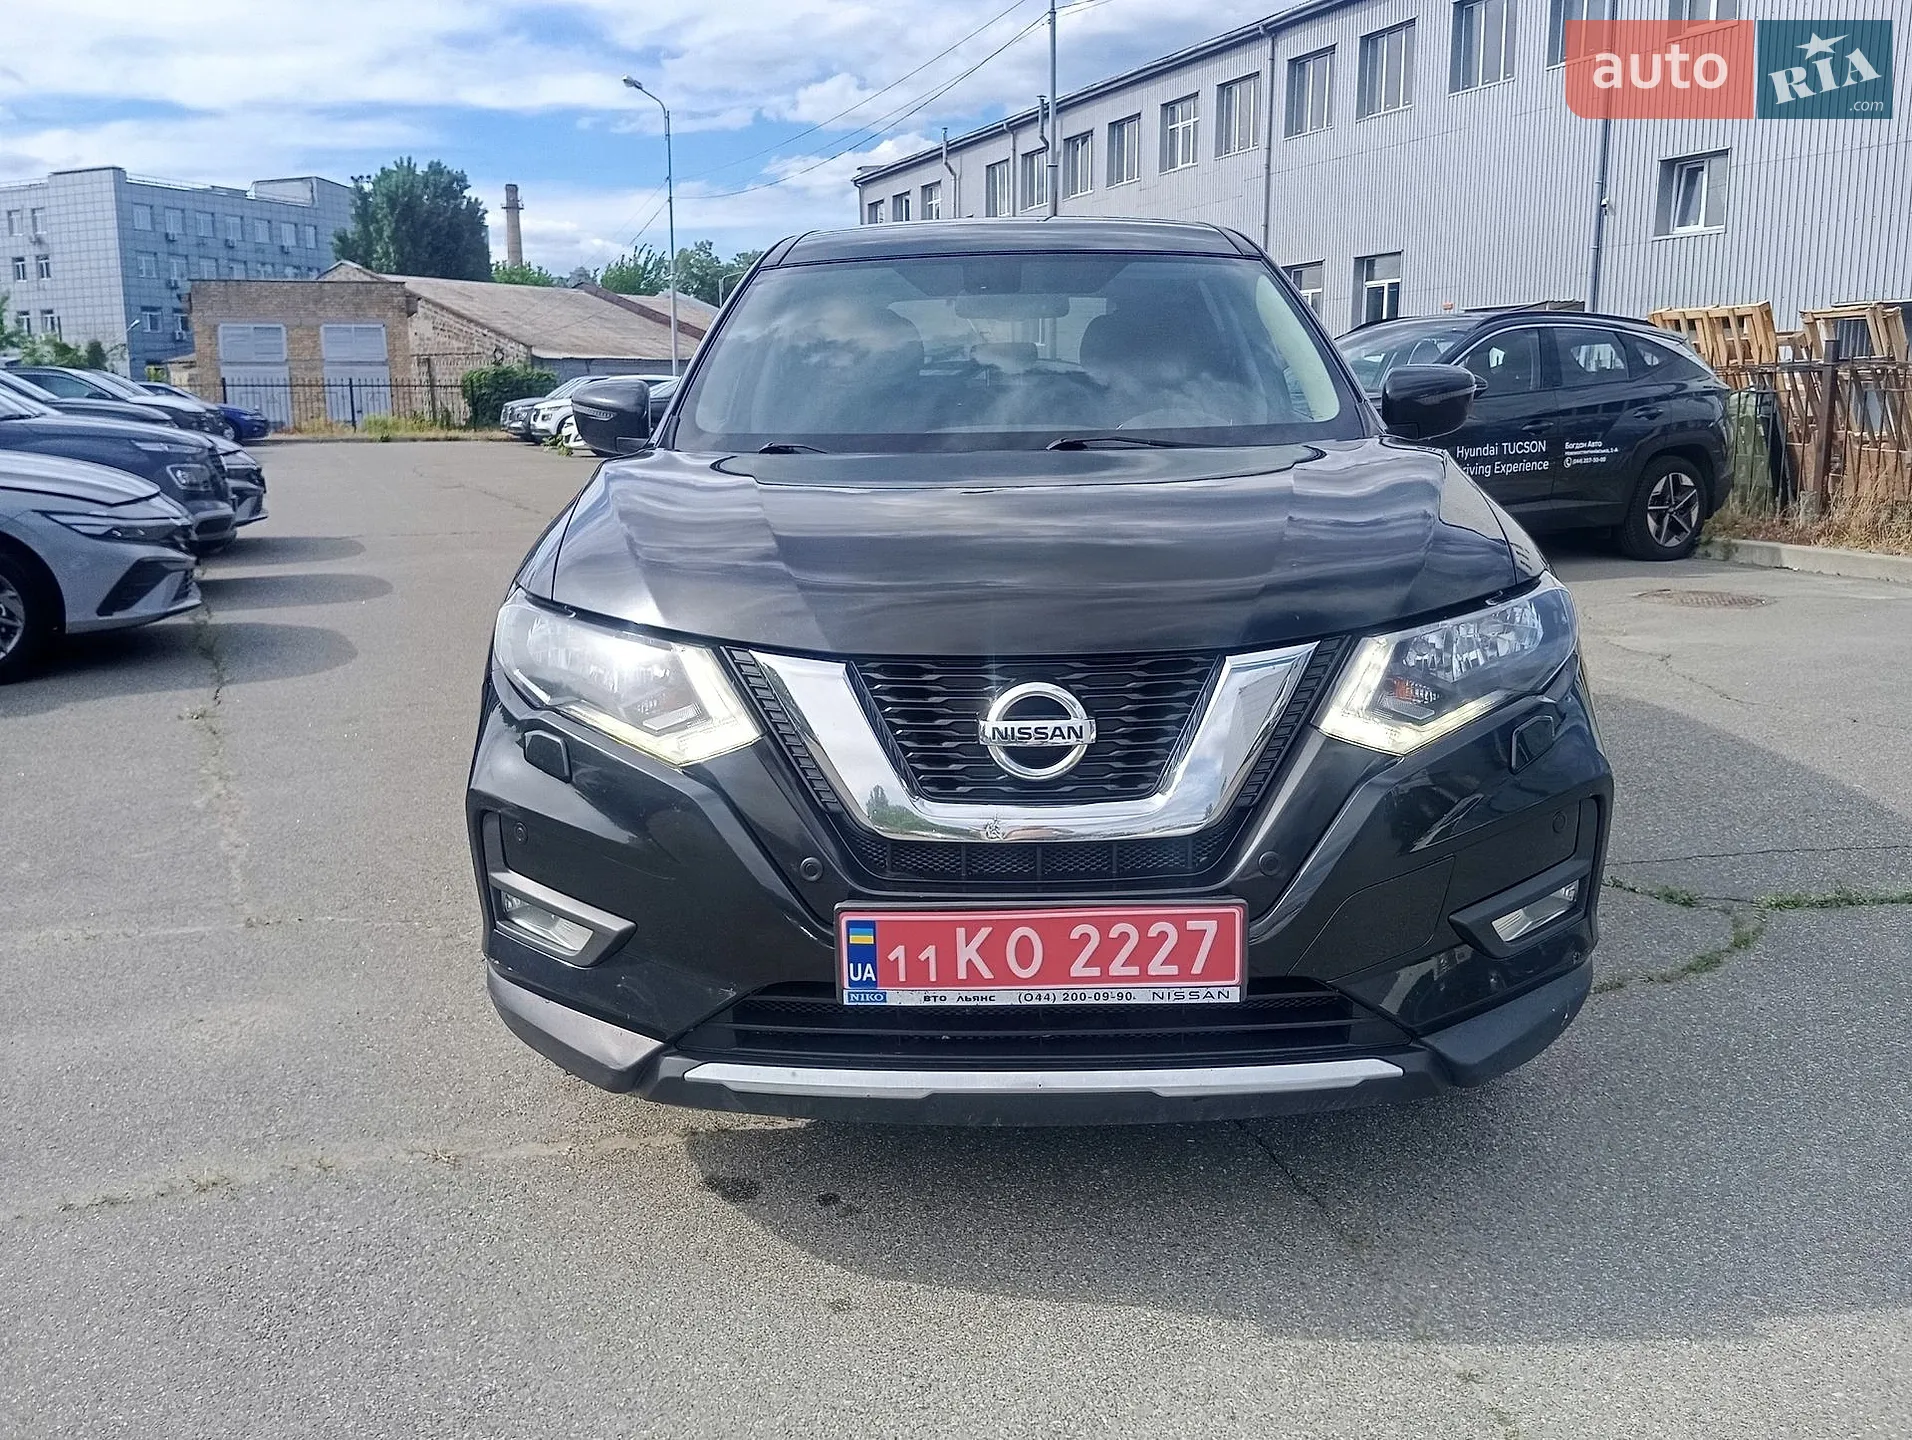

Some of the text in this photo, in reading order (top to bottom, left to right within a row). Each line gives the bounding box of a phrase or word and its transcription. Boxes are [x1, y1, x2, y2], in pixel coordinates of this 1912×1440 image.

[1456, 443, 1499, 461] Hyundai
[1502, 440, 1547, 455] TUCSON
[1462, 459, 1550, 478] riving Experience
[991, 725, 1084, 741] NISSAN
[1069, 920, 1219, 978] 2227
[849, 963, 876, 981] UA
[850, 991, 885, 1002] NIKO
[1018, 991, 1057, 1004] (044)
[1152, 990, 1231, 1001] NISSAN
